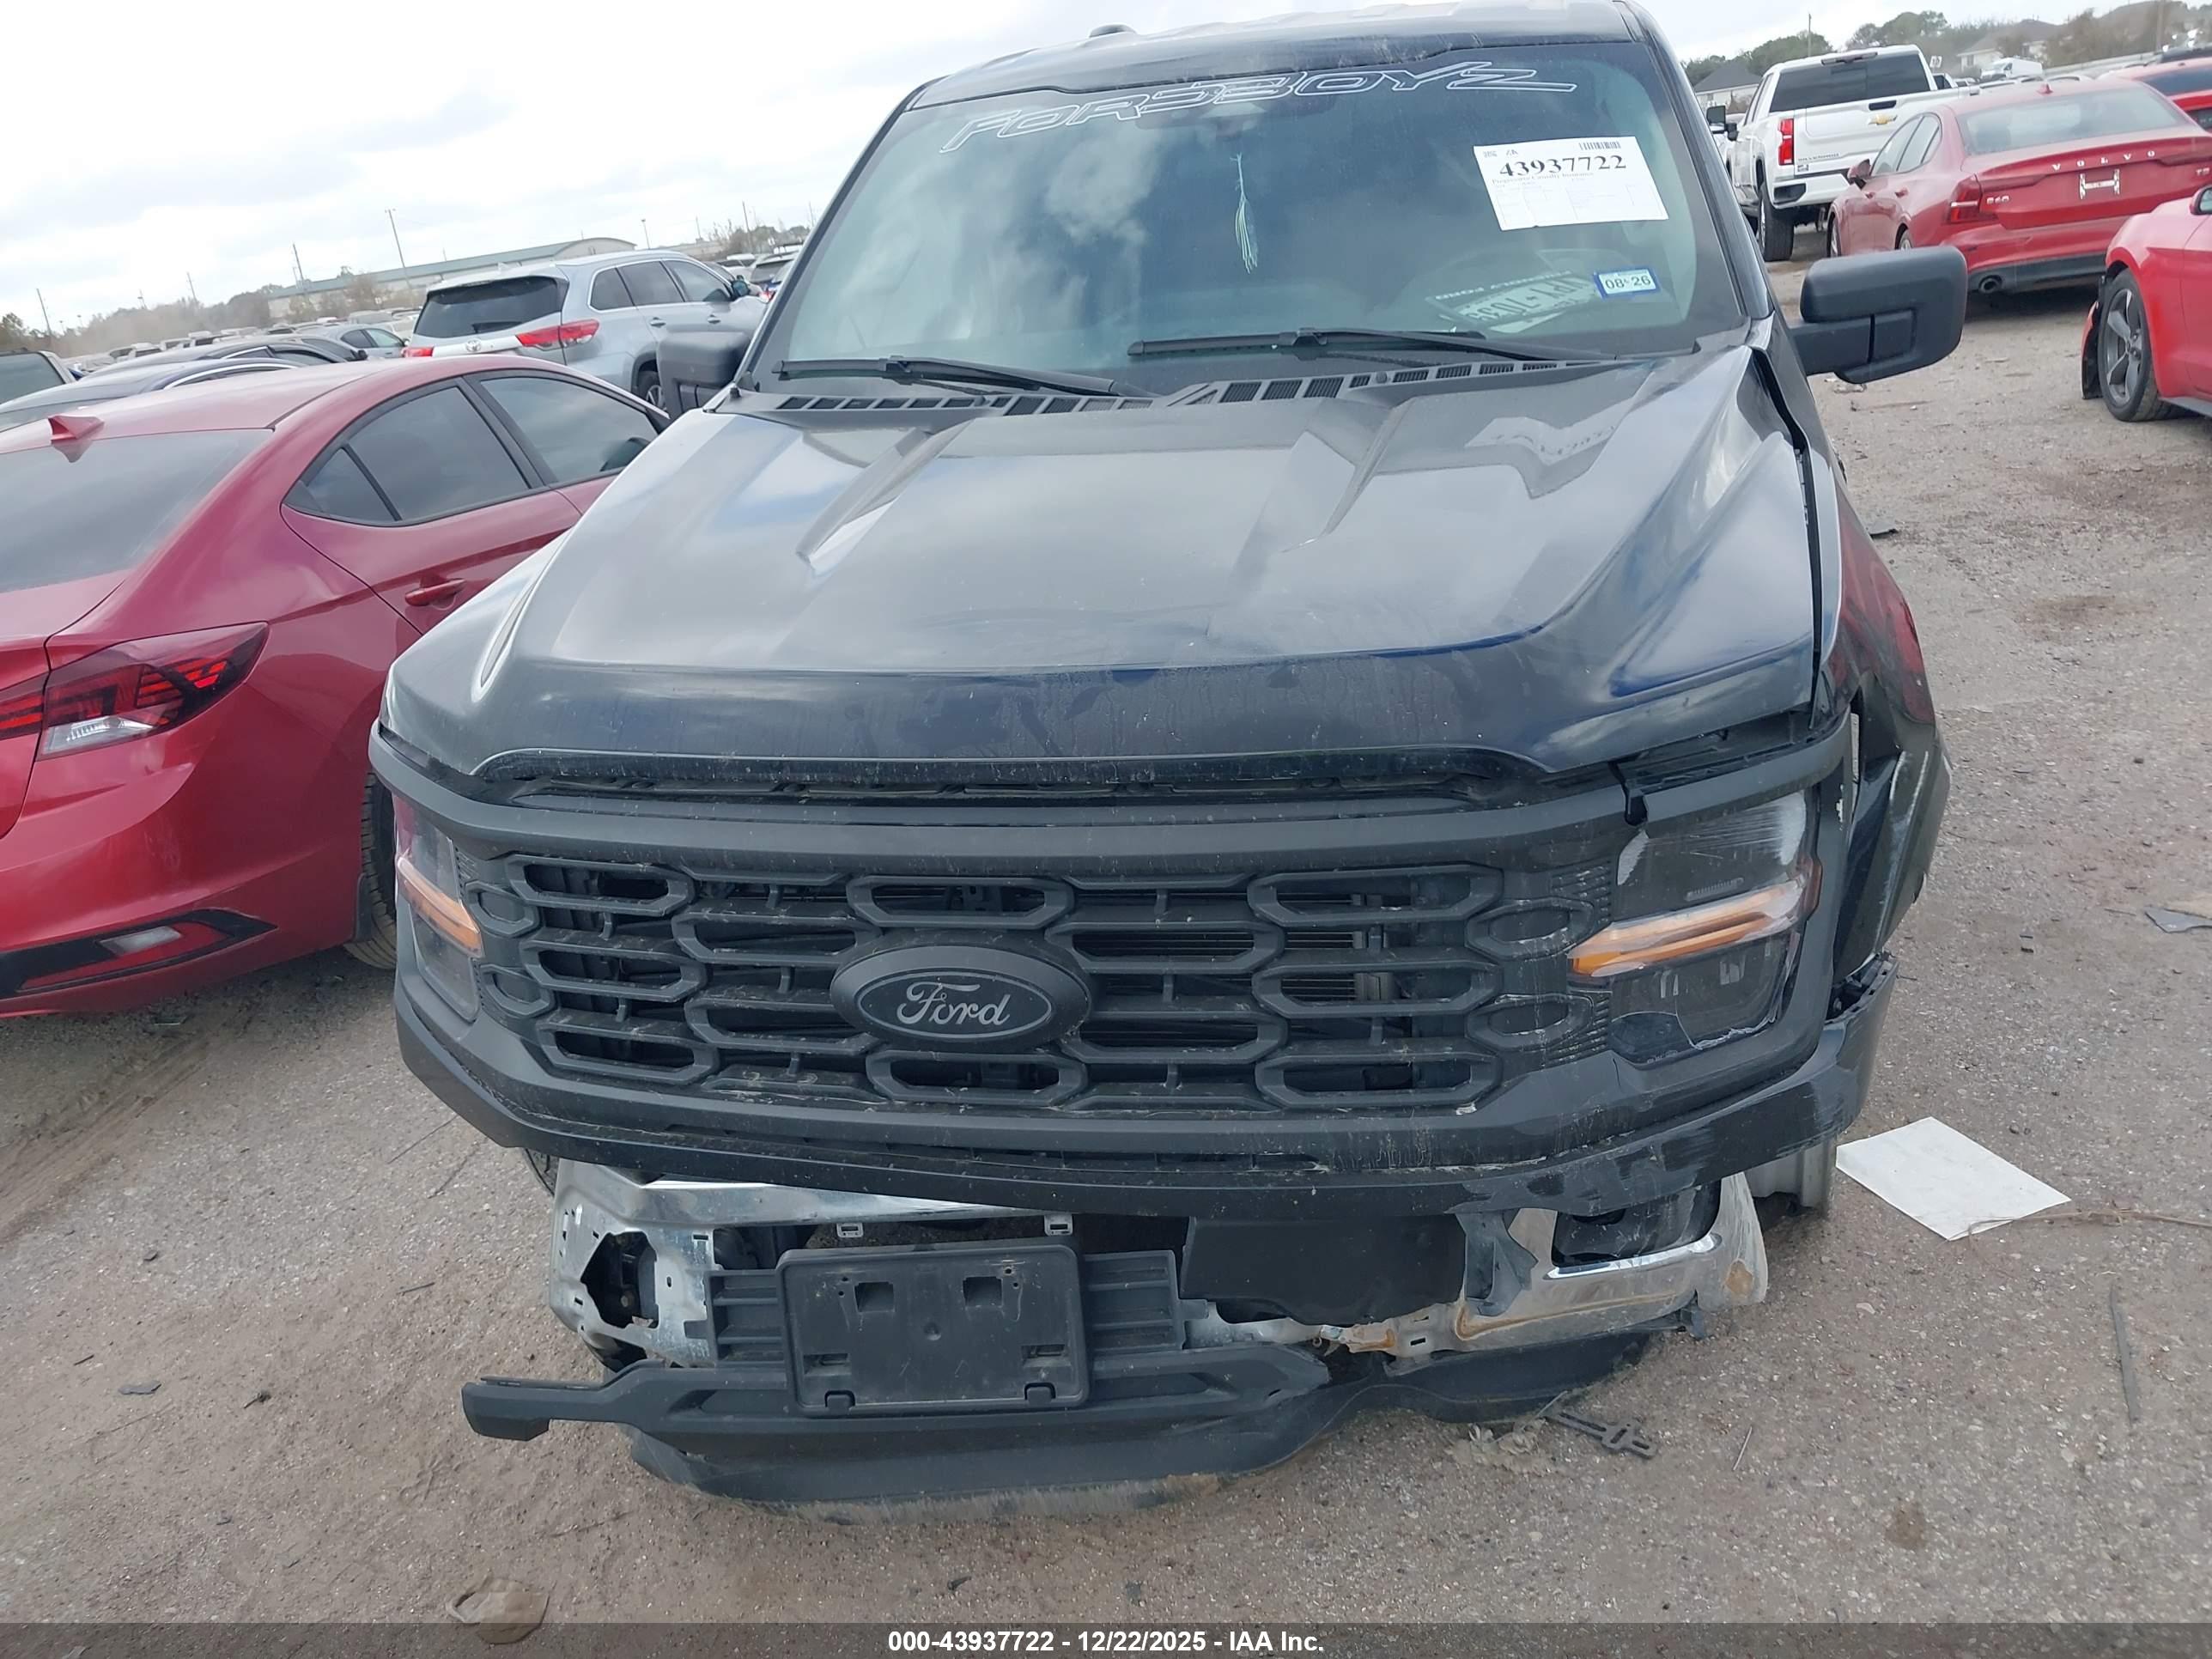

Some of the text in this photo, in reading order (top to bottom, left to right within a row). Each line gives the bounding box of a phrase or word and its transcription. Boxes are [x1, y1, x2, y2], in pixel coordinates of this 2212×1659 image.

[1499, 155, 1626, 177] 43937722
[2052, 150, 2155, 172] VOLVO
[896, 981, 1010, 1025] Ford
